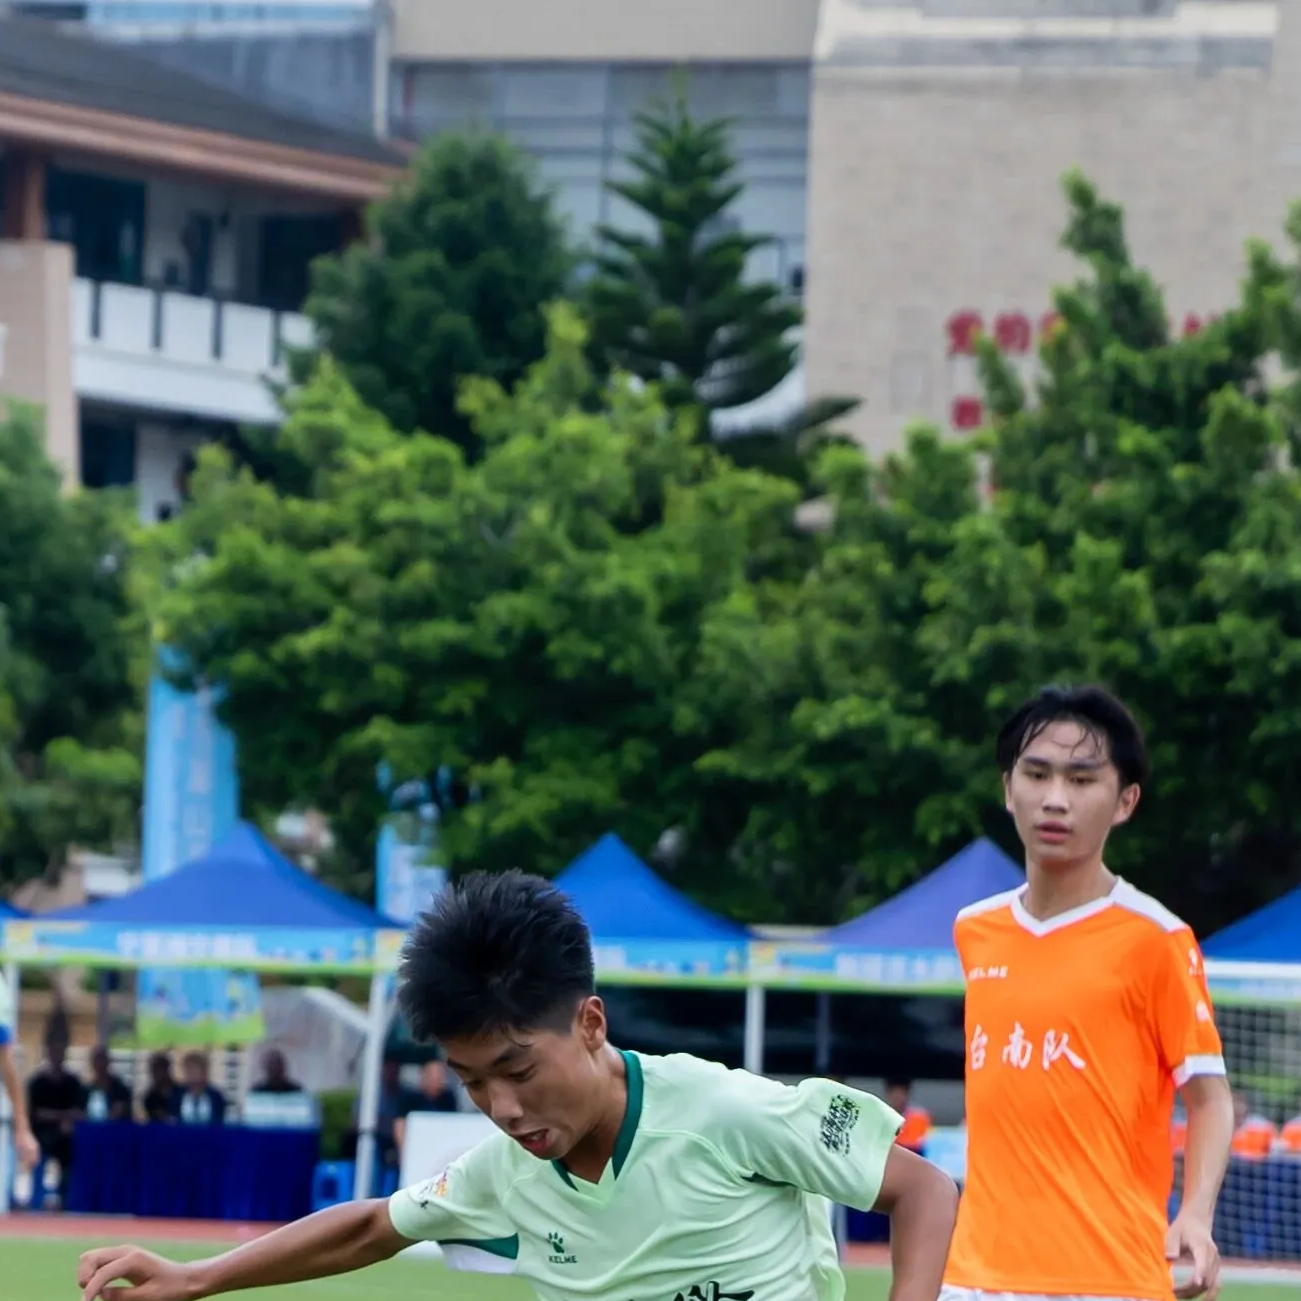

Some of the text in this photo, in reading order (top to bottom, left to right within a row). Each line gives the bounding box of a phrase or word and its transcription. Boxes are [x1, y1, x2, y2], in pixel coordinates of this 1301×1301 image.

[970, 1020, 1086, 1070] 台南队
[548, 1255, 578, 1264] KELME
